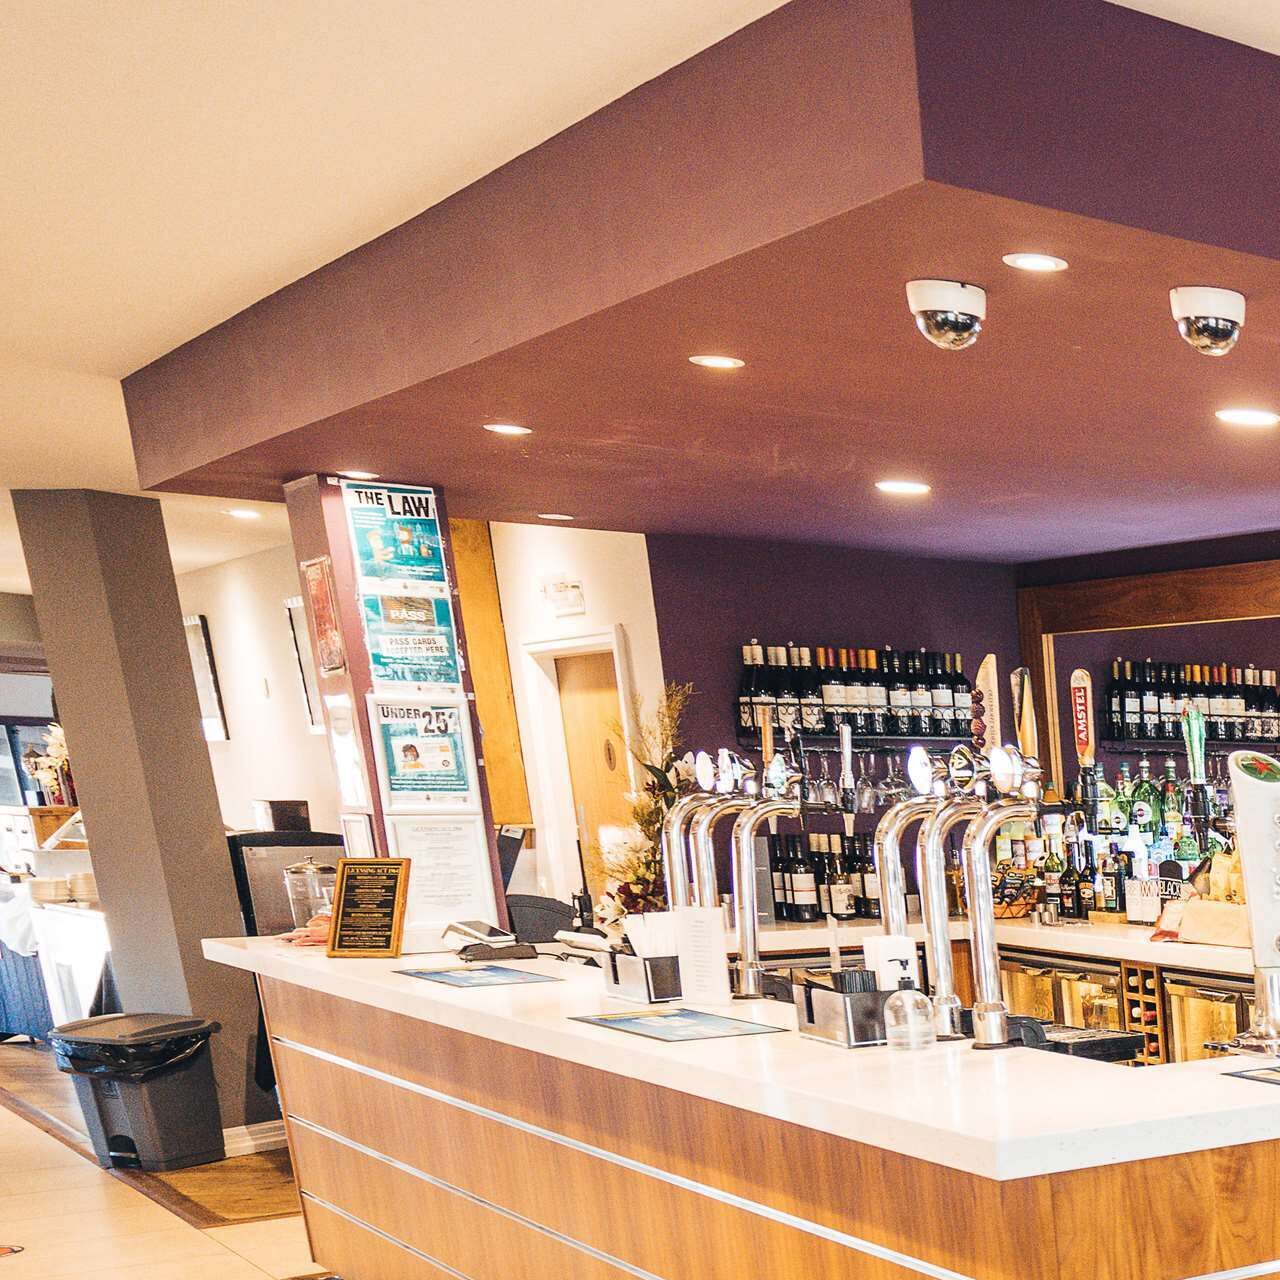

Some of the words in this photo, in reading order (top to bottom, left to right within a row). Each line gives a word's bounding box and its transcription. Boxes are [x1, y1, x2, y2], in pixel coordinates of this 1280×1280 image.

[355, 490, 385, 506] THE
[387, 494, 431, 518] LAW
[389, 609, 426, 622] PASS
[425, 646, 445, 654] HERE
[381, 706, 421, 720] UNDER
[1076, 688, 1088, 742] AMSTEL
